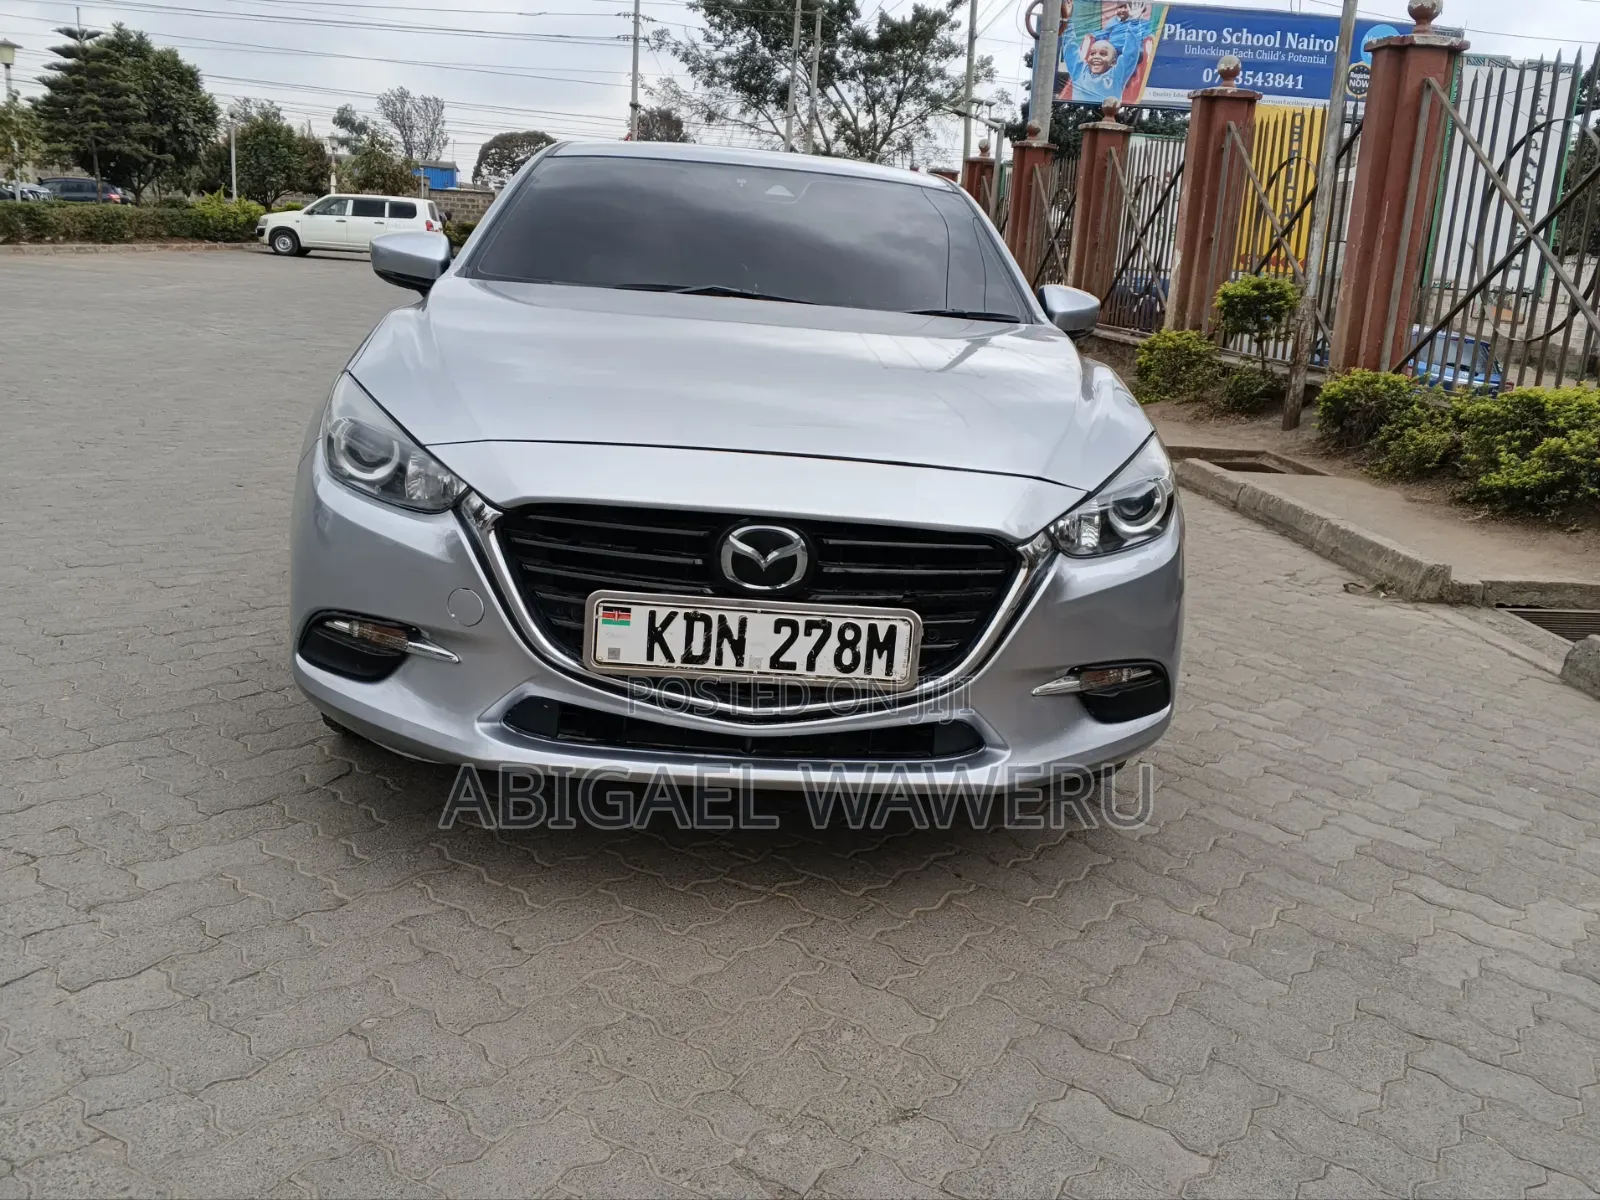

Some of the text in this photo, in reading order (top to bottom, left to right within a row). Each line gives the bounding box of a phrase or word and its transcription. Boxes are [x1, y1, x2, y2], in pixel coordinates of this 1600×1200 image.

[1163, 23, 1217, 43] Pharo
[1221, 28, 1281, 48] School
[1184, 44, 1328, 65] Unlocking Each Child's Potential
[1203, 68, 1304, 89] 073543841
[1349, 79, 1370, 88] NOW
[646, 609, 748, 667] KDN
[769, 617, 897, 677] 278M
